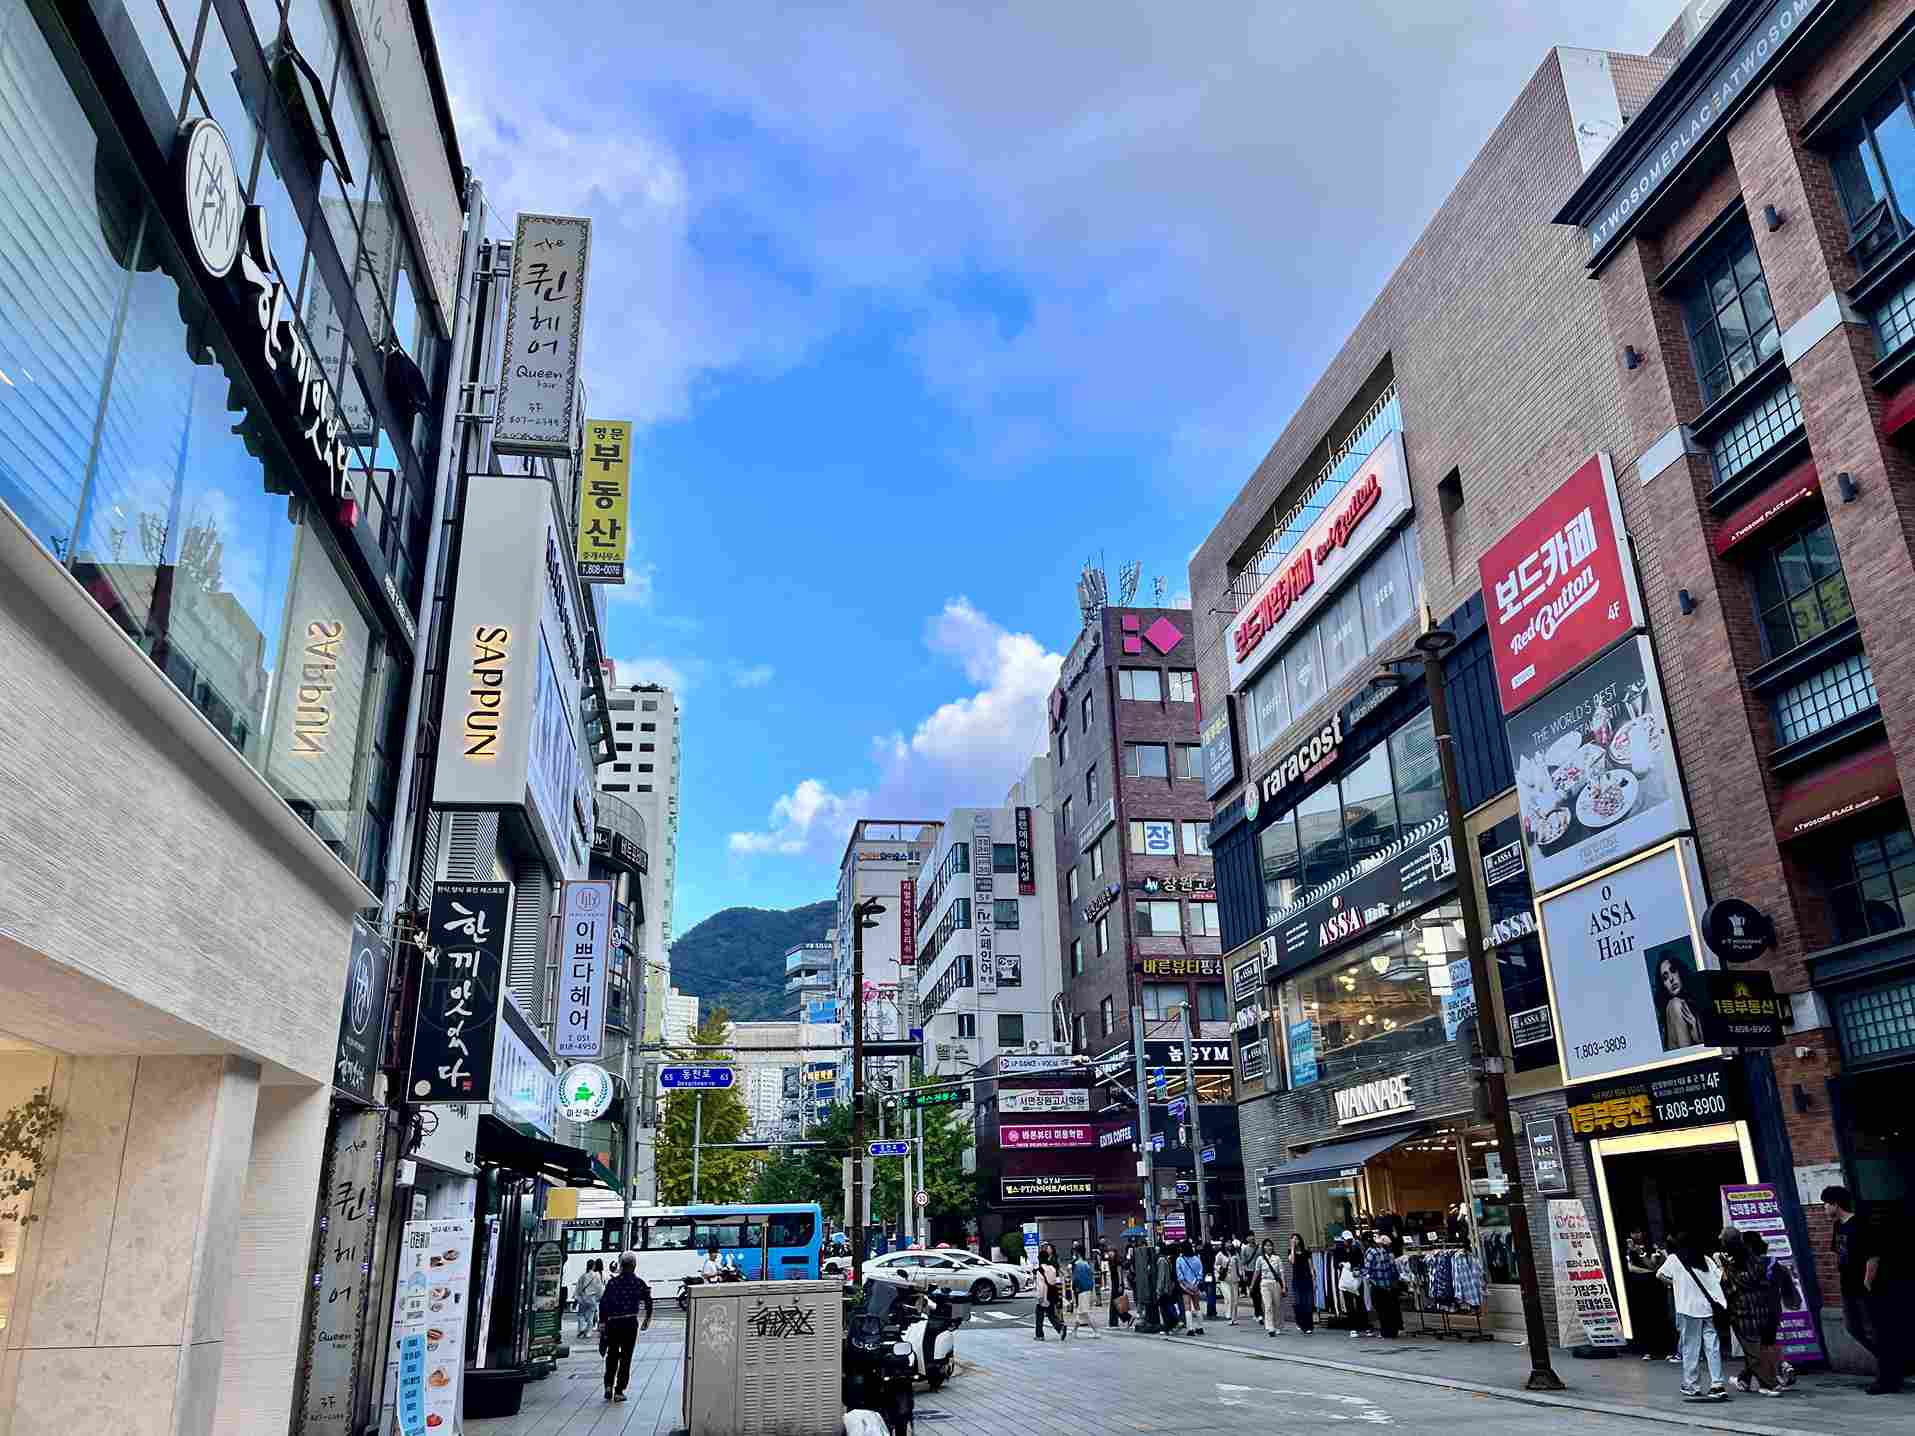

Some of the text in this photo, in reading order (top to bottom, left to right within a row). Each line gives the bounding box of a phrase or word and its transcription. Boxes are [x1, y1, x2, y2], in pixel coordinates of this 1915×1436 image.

[516, 365, 563, 379] Queen
[593, 427, 625, 440] 명문
[585, 443, 624, 548] 부동산
[1495, 506, 1599, 626] 보드카페
[1510, 565, 1600, 656] Red Button
[1608, 601, 1621, 621] 4F
[1263, 713, 1344, 803] raracost
[1146, 824, 1172, 851] 장
[1319, 905, 1363, 948] ASSA
[1590, 899, 1637, 936] ASSA
[979, 926, 993, 974] 스페인어
[1596, 930, 1636, 962] Hair
[1143, 959, 1200, 975] 바른뷰티
[1713, 999, 1775, 1015] 1등부동산
[1574, 1035, 1628, 1062] T.803-3809
[1707, 1072, 1721, 1089] 4F
[1335, 1073, 1412, 1121] WANNABE
[1656, 1095, 1727, 1122] T.808-8900
[1568, 1093, 1651, 1134] 1등부동산
[1112, 1126, 1132, 1144] COFFEE
[318, 1330, 352, 1342] Queen
